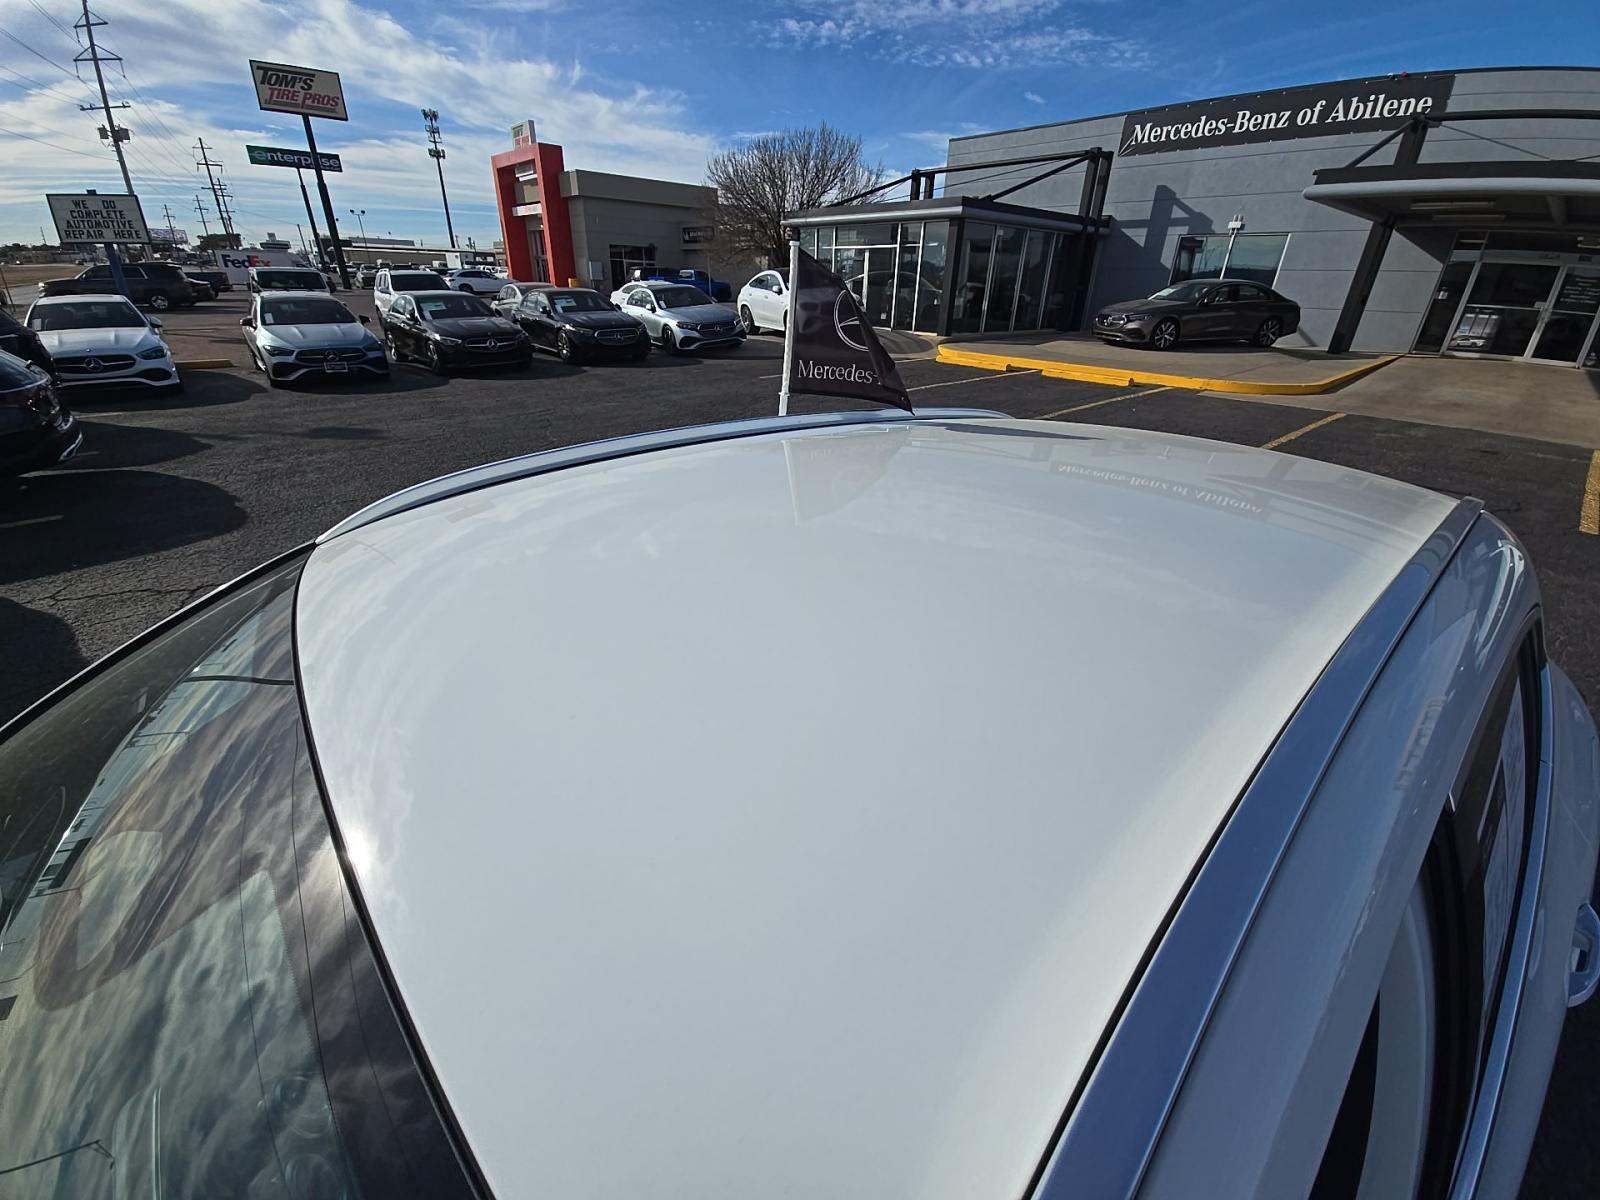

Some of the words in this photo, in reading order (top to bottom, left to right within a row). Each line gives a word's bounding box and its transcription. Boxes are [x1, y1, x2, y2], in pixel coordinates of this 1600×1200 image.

[257, 66, 316, 91] TOM'S
[268, 87, 301, 102] TIRE
[302, 92, 340, 108] PROS
[1131, 111, 1290, 145] Mercedes-Benz
[1296, 100, 1323, 126] of
[1327, 93, 1433, 123] Abilene
[253, 150, 340, 167] enterpse
[71, 200, 88, 209] WE
[102, 200, 117, 209] DO
[70, 210, 126, 220] COMPLETE
[66, 220, 134, 230] AUTOMOTIVE
[64, 229, 105, 239] REPAIR
[114, 230, 142, 239] HERE
